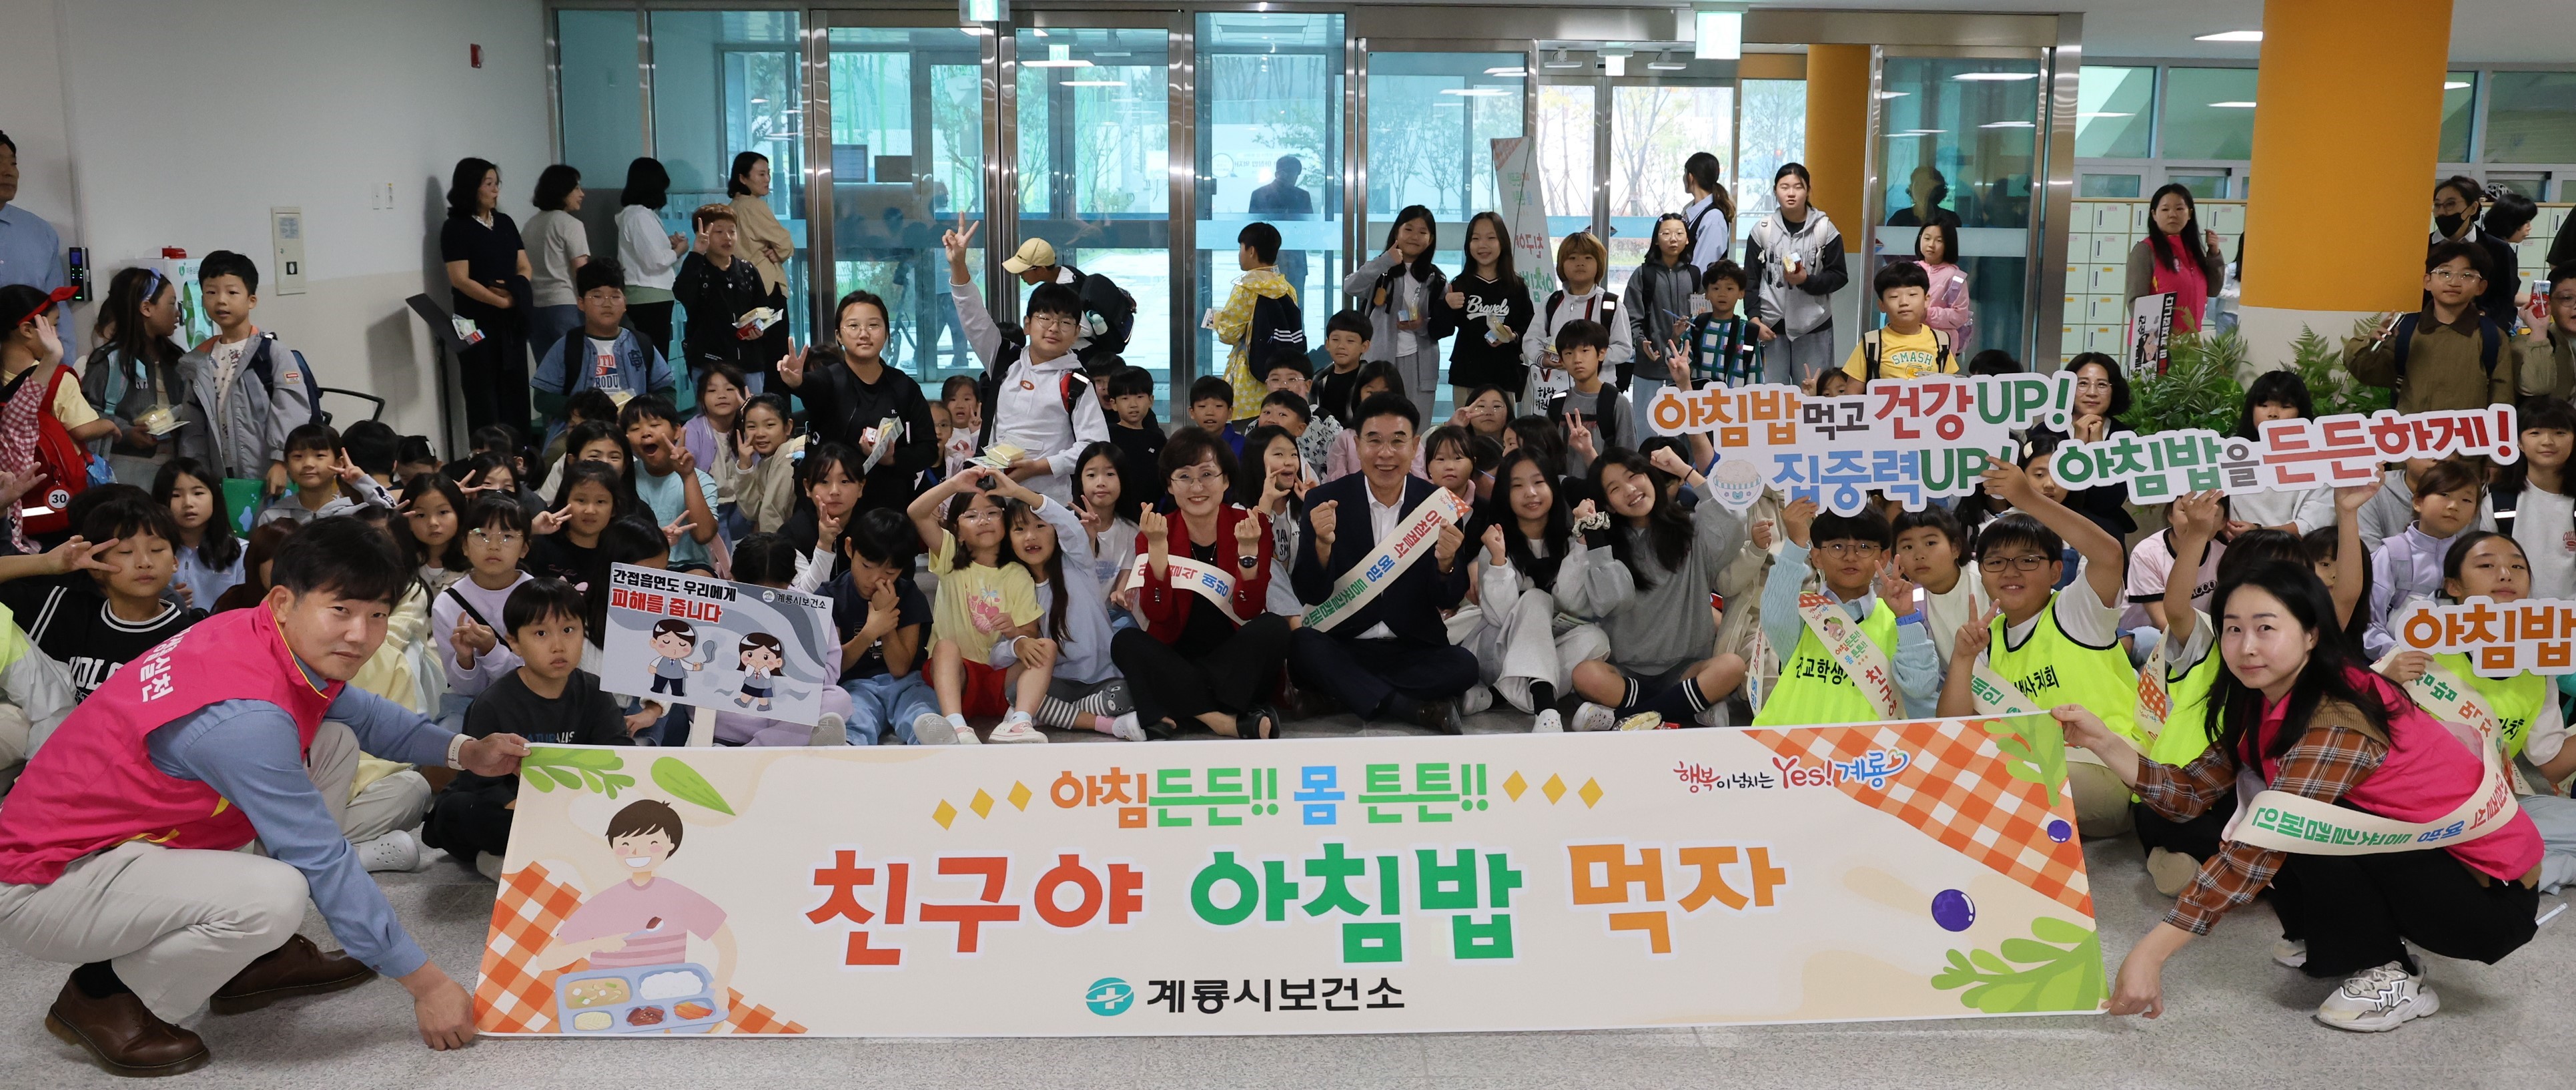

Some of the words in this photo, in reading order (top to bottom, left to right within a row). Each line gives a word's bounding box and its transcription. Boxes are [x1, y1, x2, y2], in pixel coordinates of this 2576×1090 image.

[1466, 295, 1510, 316] Bravely
[1892, 351, 1933, 365] SMASH
[51, 494, 67, 504] 30
[1392, 509, 1440, 559] 아침결식
[612, 569, 679, 593] 간접흡연도
[683, 581, 737, 602] 우리에게
[1202, 573, 1229, 597] 예방
[1366, 554, 1396, 583] 예방
[610, 588, 664, 613] 피해를
[669, 597, 723, 623] 줍니다
[777, 593, 827, 609] 계룡시보건소
[2403, 603, 2576, 669] 아침밥
[1844, 655, 1854, 665] 몸
[1865, 665, 1897, 717] 친구야
[2459, 700, 2493, 738] 먹자
[1772, 757, 1835, 788] Yes!
[1835, 752, 1887, 788] 계룡
[1050, 766, 1279, 829] 아침든든!!
[1294, 766, 1346, 825] 몸
[1358, 763, 1488, 824] 튼튼!!
[2417, 820, 2465, 842] 예방
[805, 850, 1143, 966] 친구야
[1190, 842, 1523, 963] 아침밥
[1567, 844, 1786, 955] 먹자
[1146, 977, 1405, 1015] 계룡시보건소
